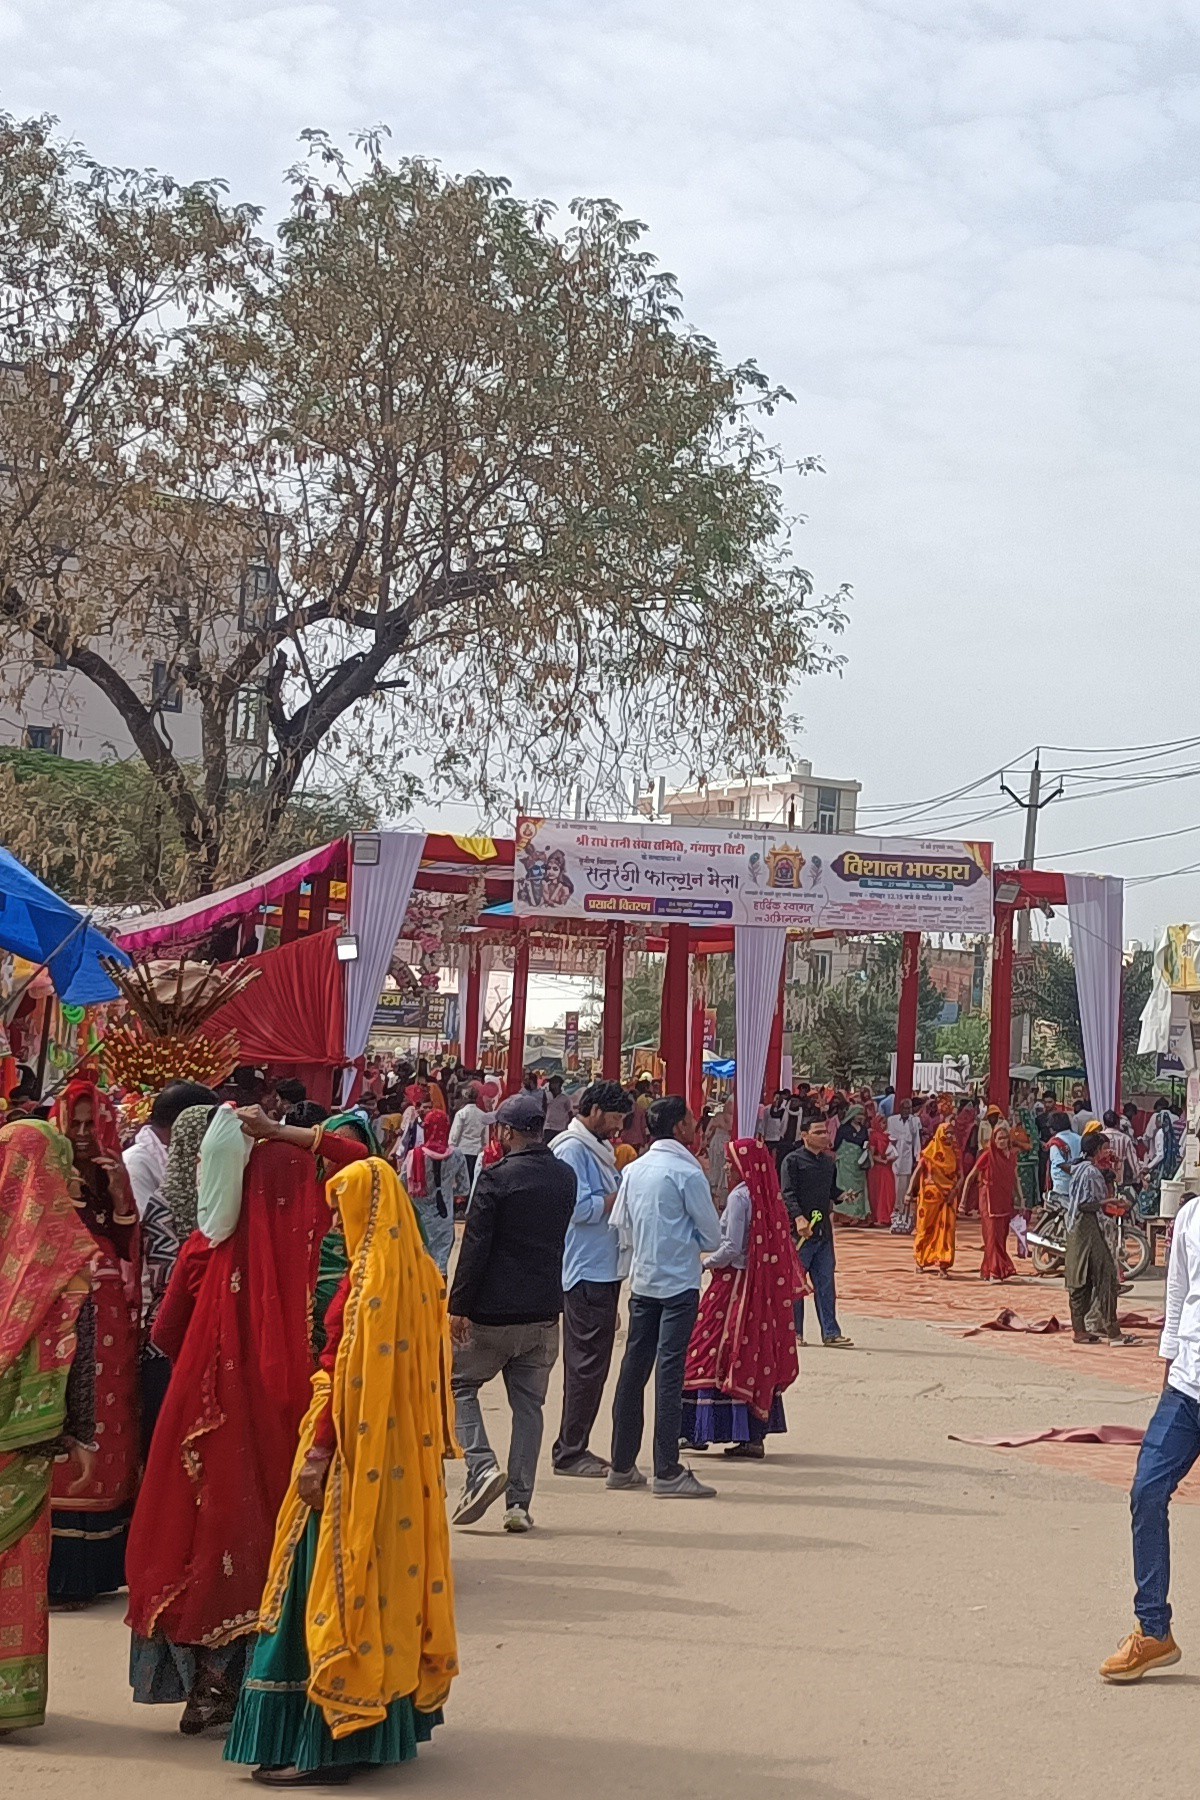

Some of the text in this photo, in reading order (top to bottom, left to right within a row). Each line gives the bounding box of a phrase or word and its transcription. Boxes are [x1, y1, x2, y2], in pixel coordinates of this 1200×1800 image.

[576, 835, 589, 847] श्री
[591, 835, 608, 848] राधे
[610, 837, 631, 849] रानी
[633, 837, 652, 851] सेवा
[690, 841, 721, 857] गंगापुर
[724, 842, 746, 855] सिटी
[586, 861, 741, 894] सतरंगी फाल्गुन मेला
[843, 853, 971, 880] विशाल भण्डारा
[588, 897, 617, 911] प्रसादी
[619, 898, 651, 912] वितरण
[753, 897, 782, 910] हार्दिक
[783, 902, 815, 913] स्वागत
